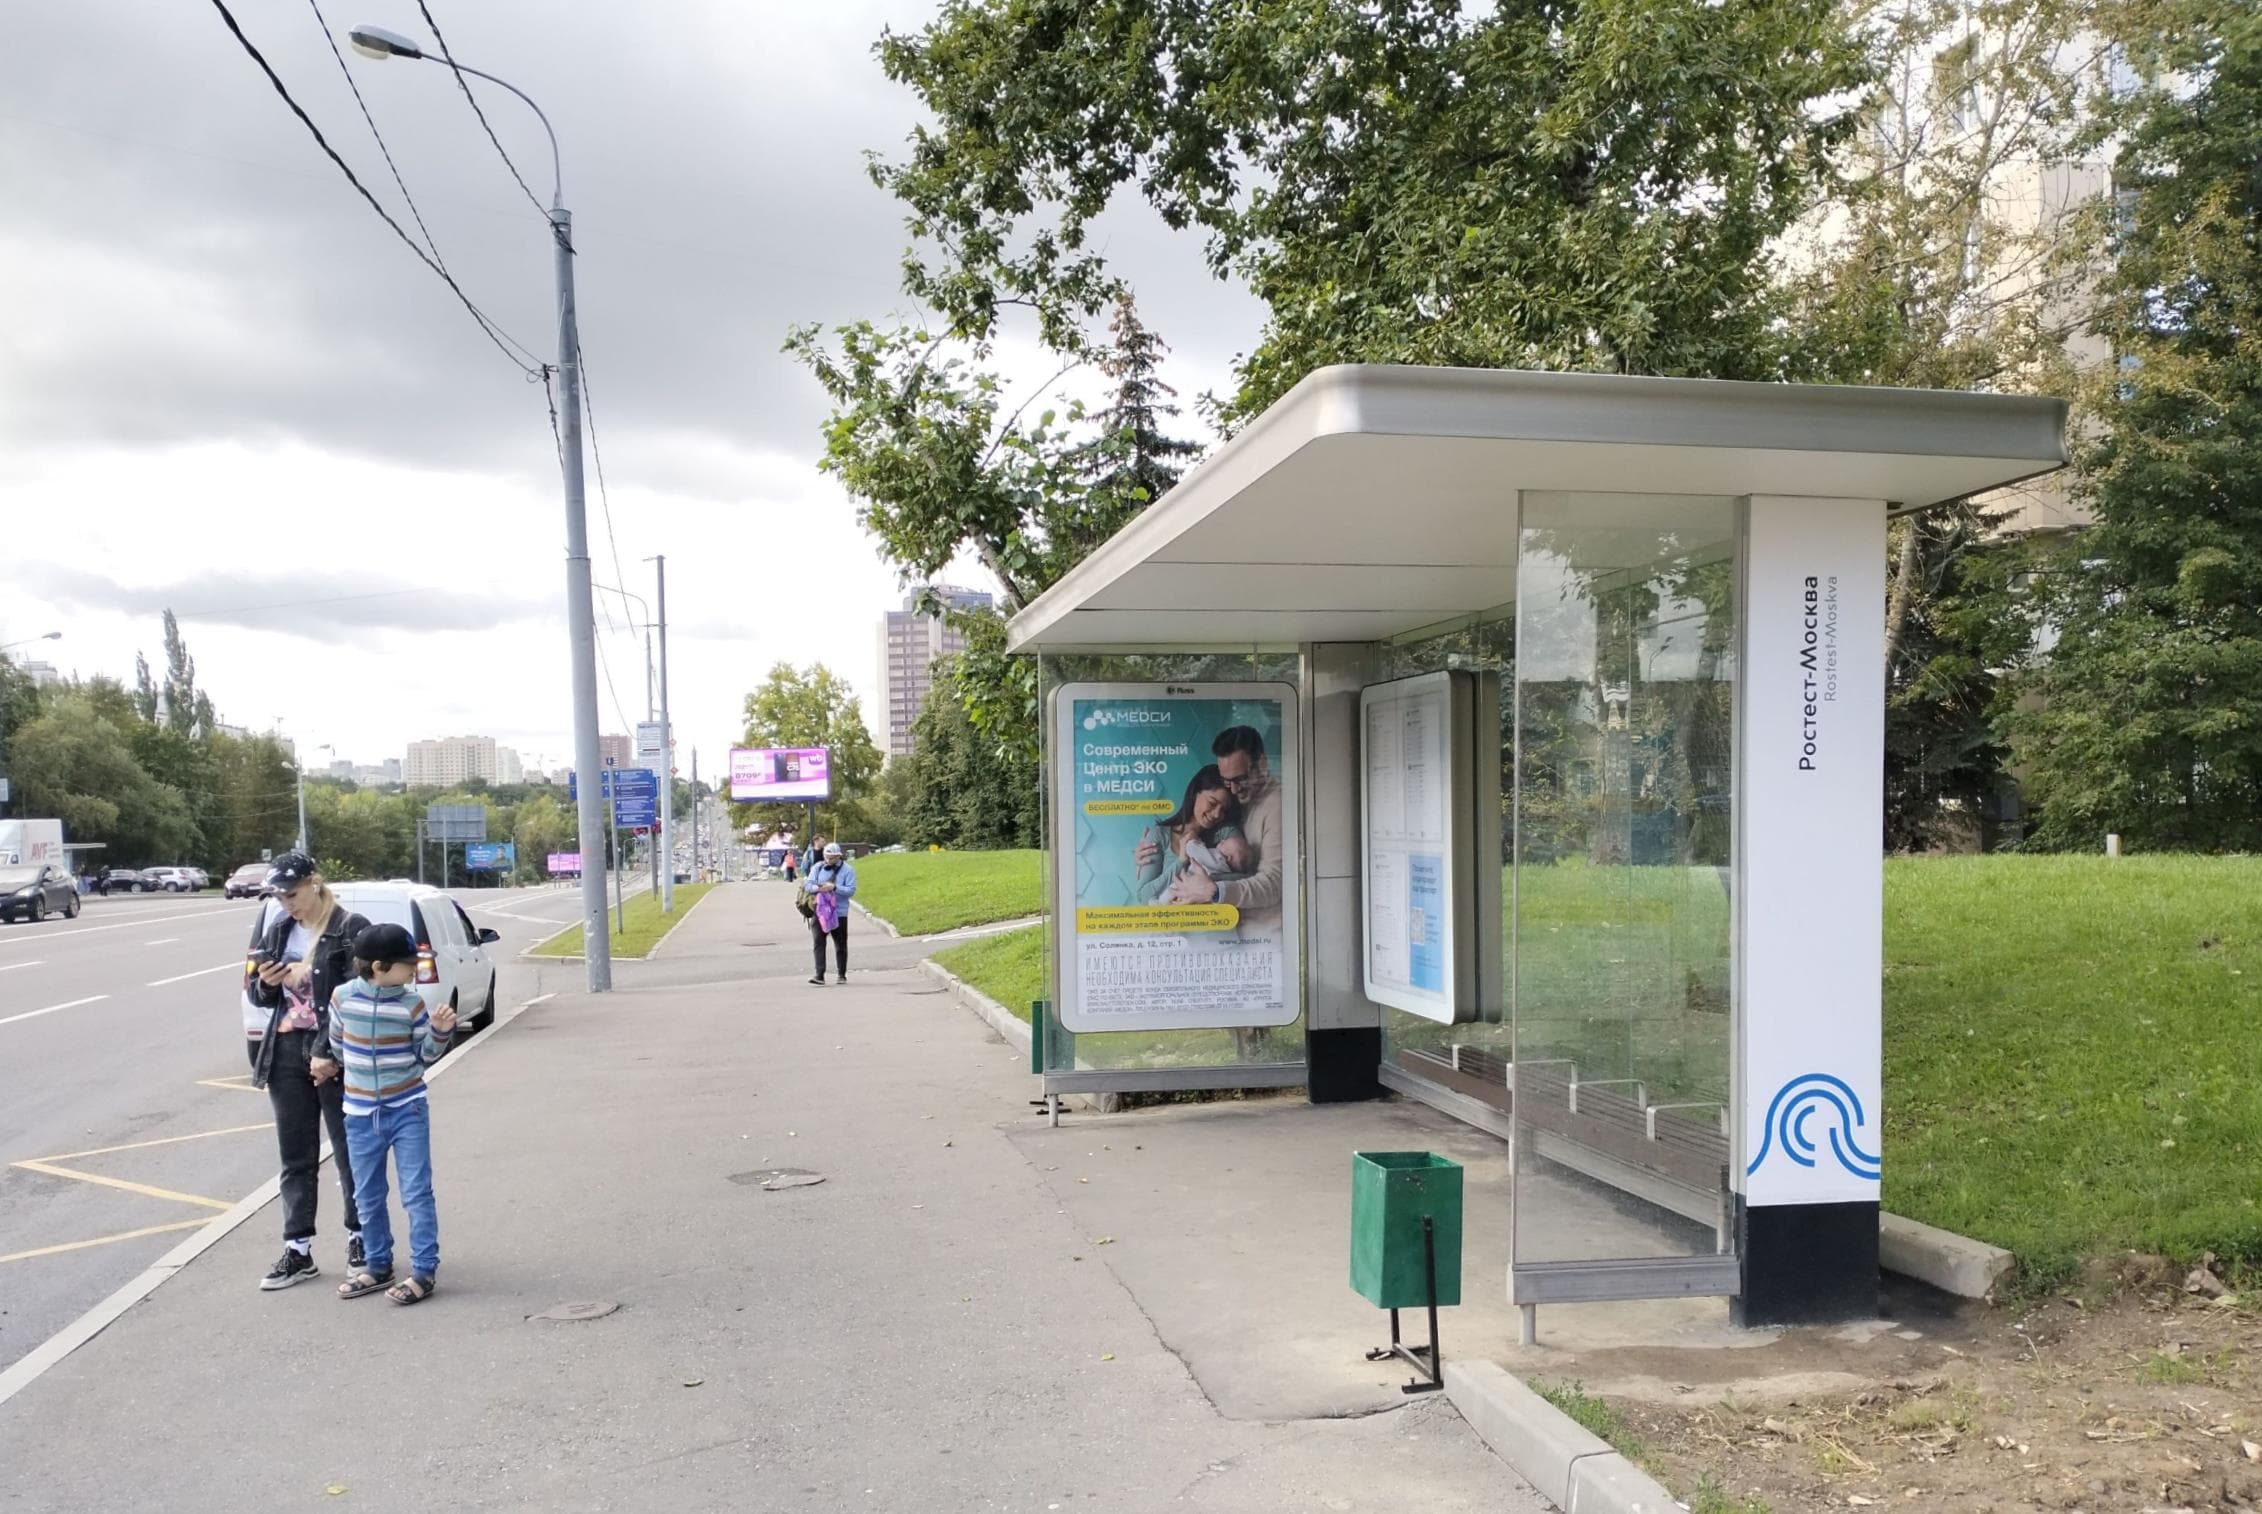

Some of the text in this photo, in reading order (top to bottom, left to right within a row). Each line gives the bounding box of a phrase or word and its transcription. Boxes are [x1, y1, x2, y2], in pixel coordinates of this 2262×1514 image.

[1824, 576, 1838, 702] Rostest-Moskva
[1799, 576, 1818, 771] Ростест-Москва
[1083, 742, 1189, 758] Современный
[1083, 760, 1168, 776] Центр ЭКО
[1084, 780, 1155, 795] в МЕДСИ
[1152, 802, 1171, 810] ОМС
[1085, 910, 1218, 919] Максимальная эффективность
[1098, 922, 1132, 930] каждом
[1161, 921, 1209, 929] программы
[1085, 951, 1273, 971] ИМЕЮТСЯ ПРОТИВОПОКАЗАНИЯ
[1086, 966, 1273, 986] НЕОБХОДИМА КОНСУЛЬТАЦИЯ СПЕЦИАЛИСТА
